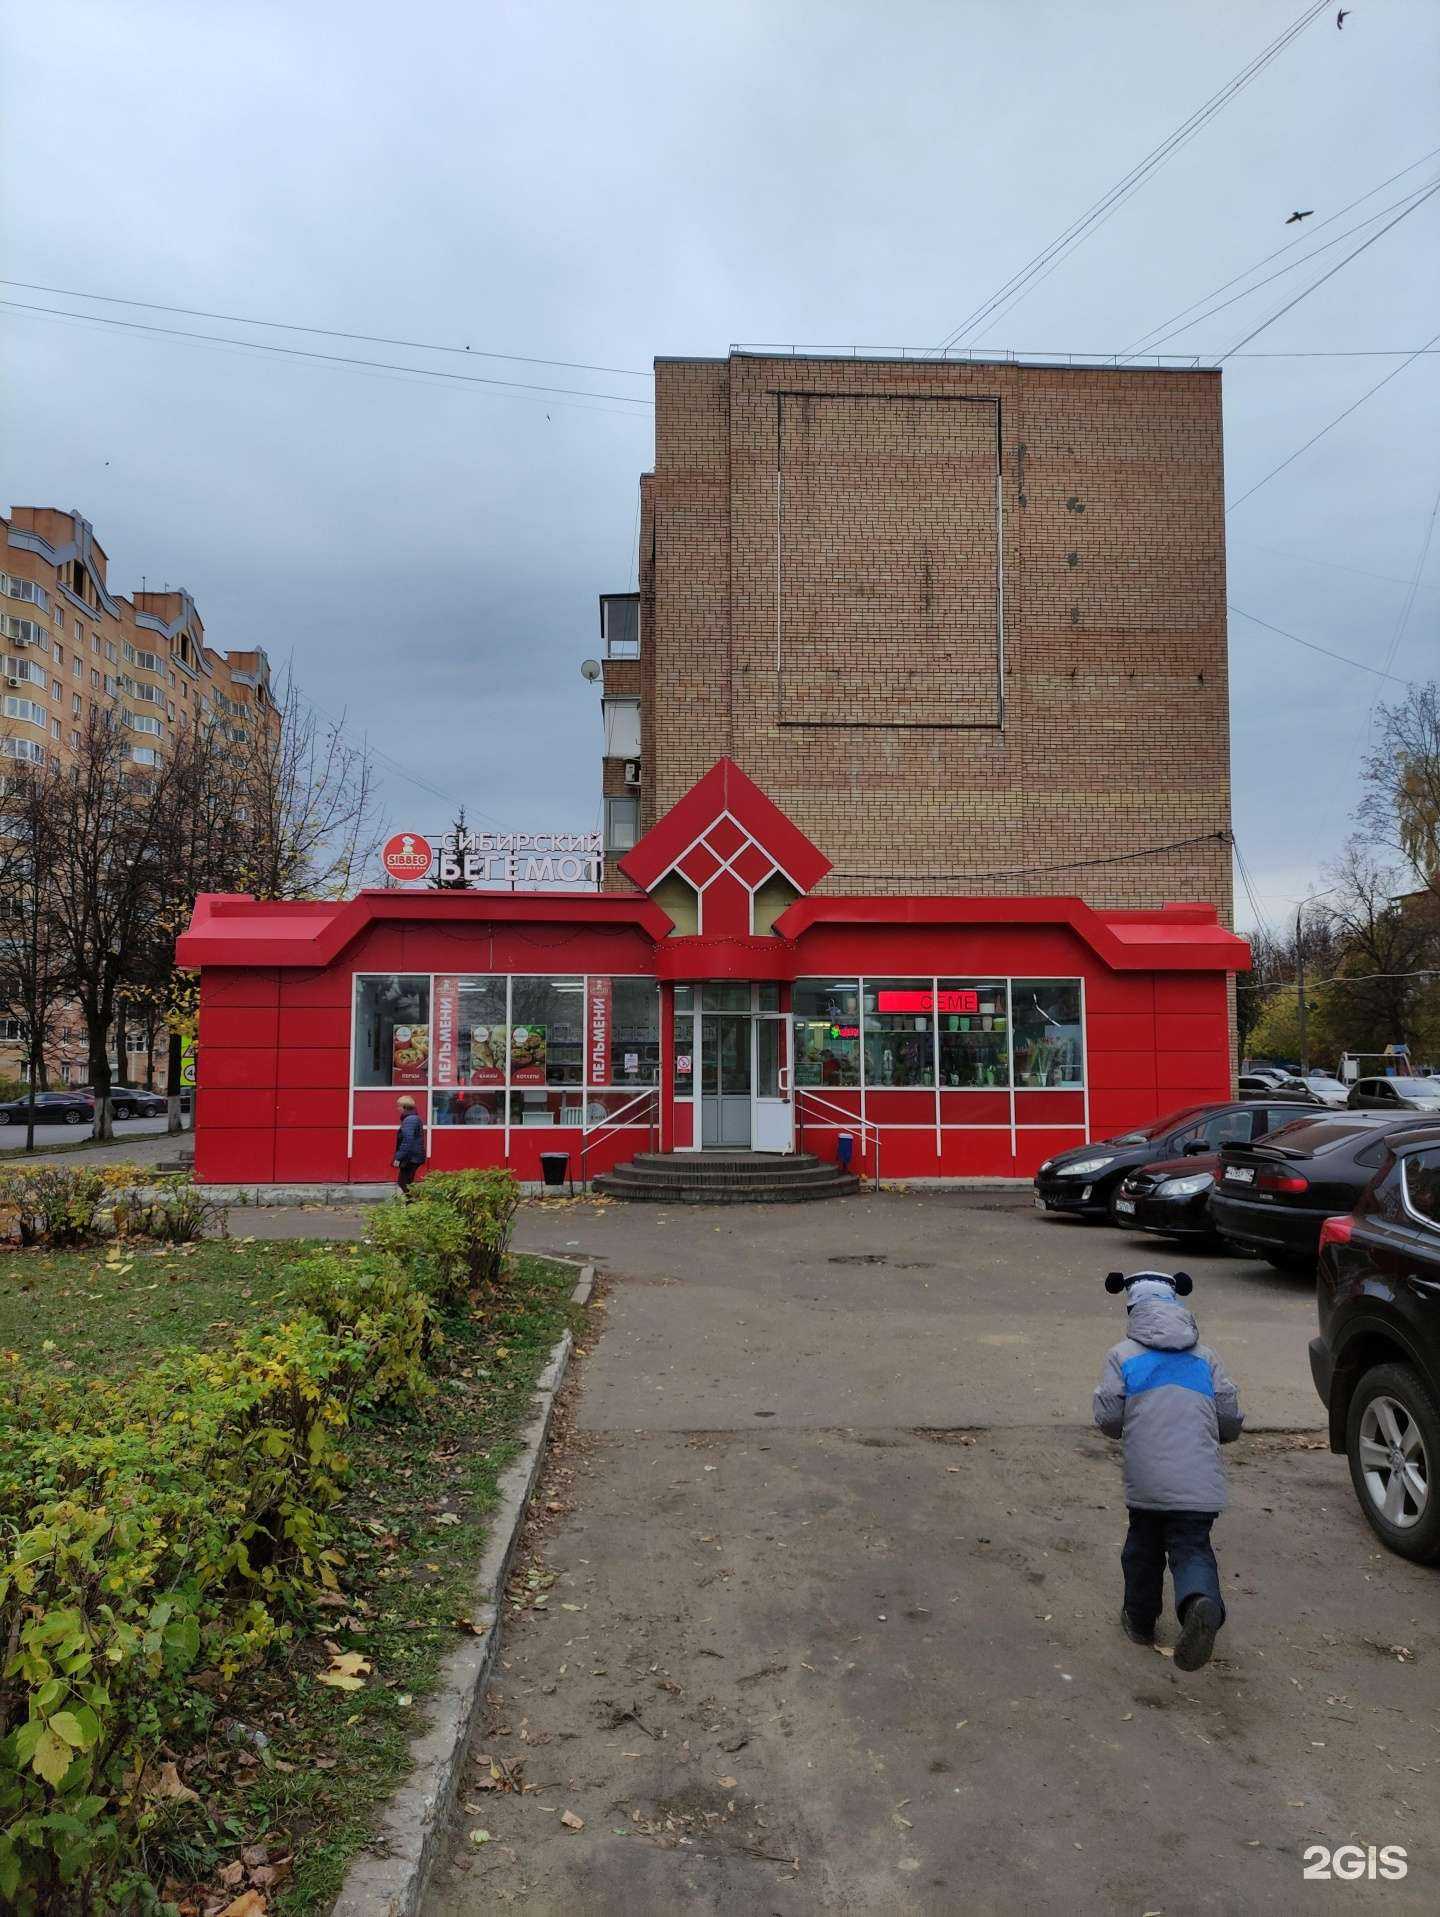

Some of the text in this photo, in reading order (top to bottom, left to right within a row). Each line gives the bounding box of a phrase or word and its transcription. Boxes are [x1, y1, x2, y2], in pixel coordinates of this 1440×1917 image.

[441, 831, 604, 853] СИБИРСКИЙ
[388, 855, 426, 864] SIBBEG
[440, 852, 604, 882] БЕГЕМОТ
[438, 998, 452, 1083] ПЕЛЬМЕНИ
[592, 998, 606, 1083] ПЕЛЬМЕНИ
